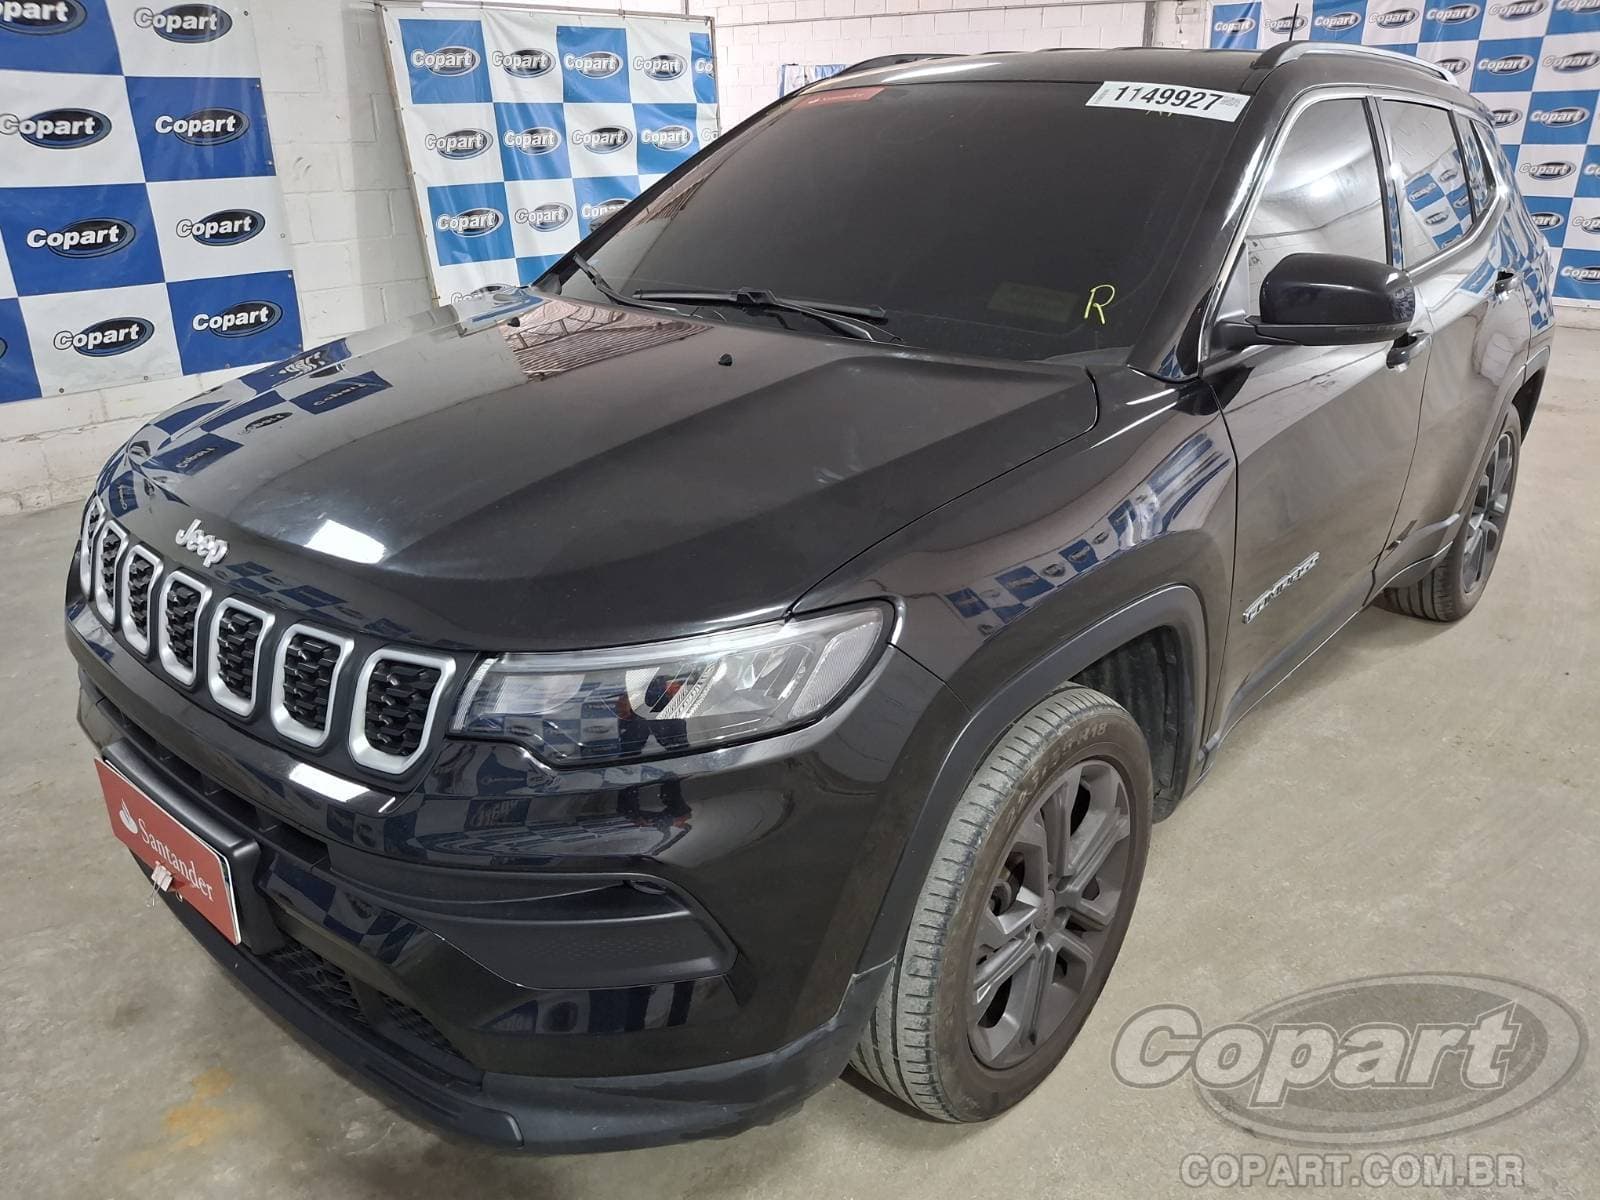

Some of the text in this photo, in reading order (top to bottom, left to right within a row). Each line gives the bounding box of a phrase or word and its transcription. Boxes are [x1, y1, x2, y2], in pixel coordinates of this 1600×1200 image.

[1369, 8, 1414, 27] Copart
[1426, 7, 1473, 21] Copart
[1488, 0, 1543, 17] Copart
[135, 7, 218, 33] Copart
[1315, 14, 1356, 28] Copart
[412, 50, 474, 70] Copart
[492, 51, 549, 72] Copart
[564, 54, 618, 74] Copart
[632, 57, 682, 75] Copart
[1478, 55, 1528, 71] Copart
[1543, 53, 1596, 69] Copart
[1114, 85, 1223, 111] 1149927
[0, 112, 97, 139] Copart
[155, 114, 237, 137] Copart
[1530, 107, 1583, 124] Copart
[425, 131, 484, 154] Copart
[504, 130, 555, 151] Copart
[572, 128, 628, 149] Copart
[641, 129, 688, 148] Copart
[1519, 163, 1568, 178] Copart
[176, 214, 252, 240] Copart
[437, 212, 498, 234] Copart
[515, 207, 567, 228] Copart
[27, 223, 120, 250] Copart
[1083, 284, 1115, 325] R
[192, 305, 270, 333] Copart
[53, 322, 141, 349] Copart
[175, 519, 228, 568] Jeep
[138, 818, 214, 903] Santander
